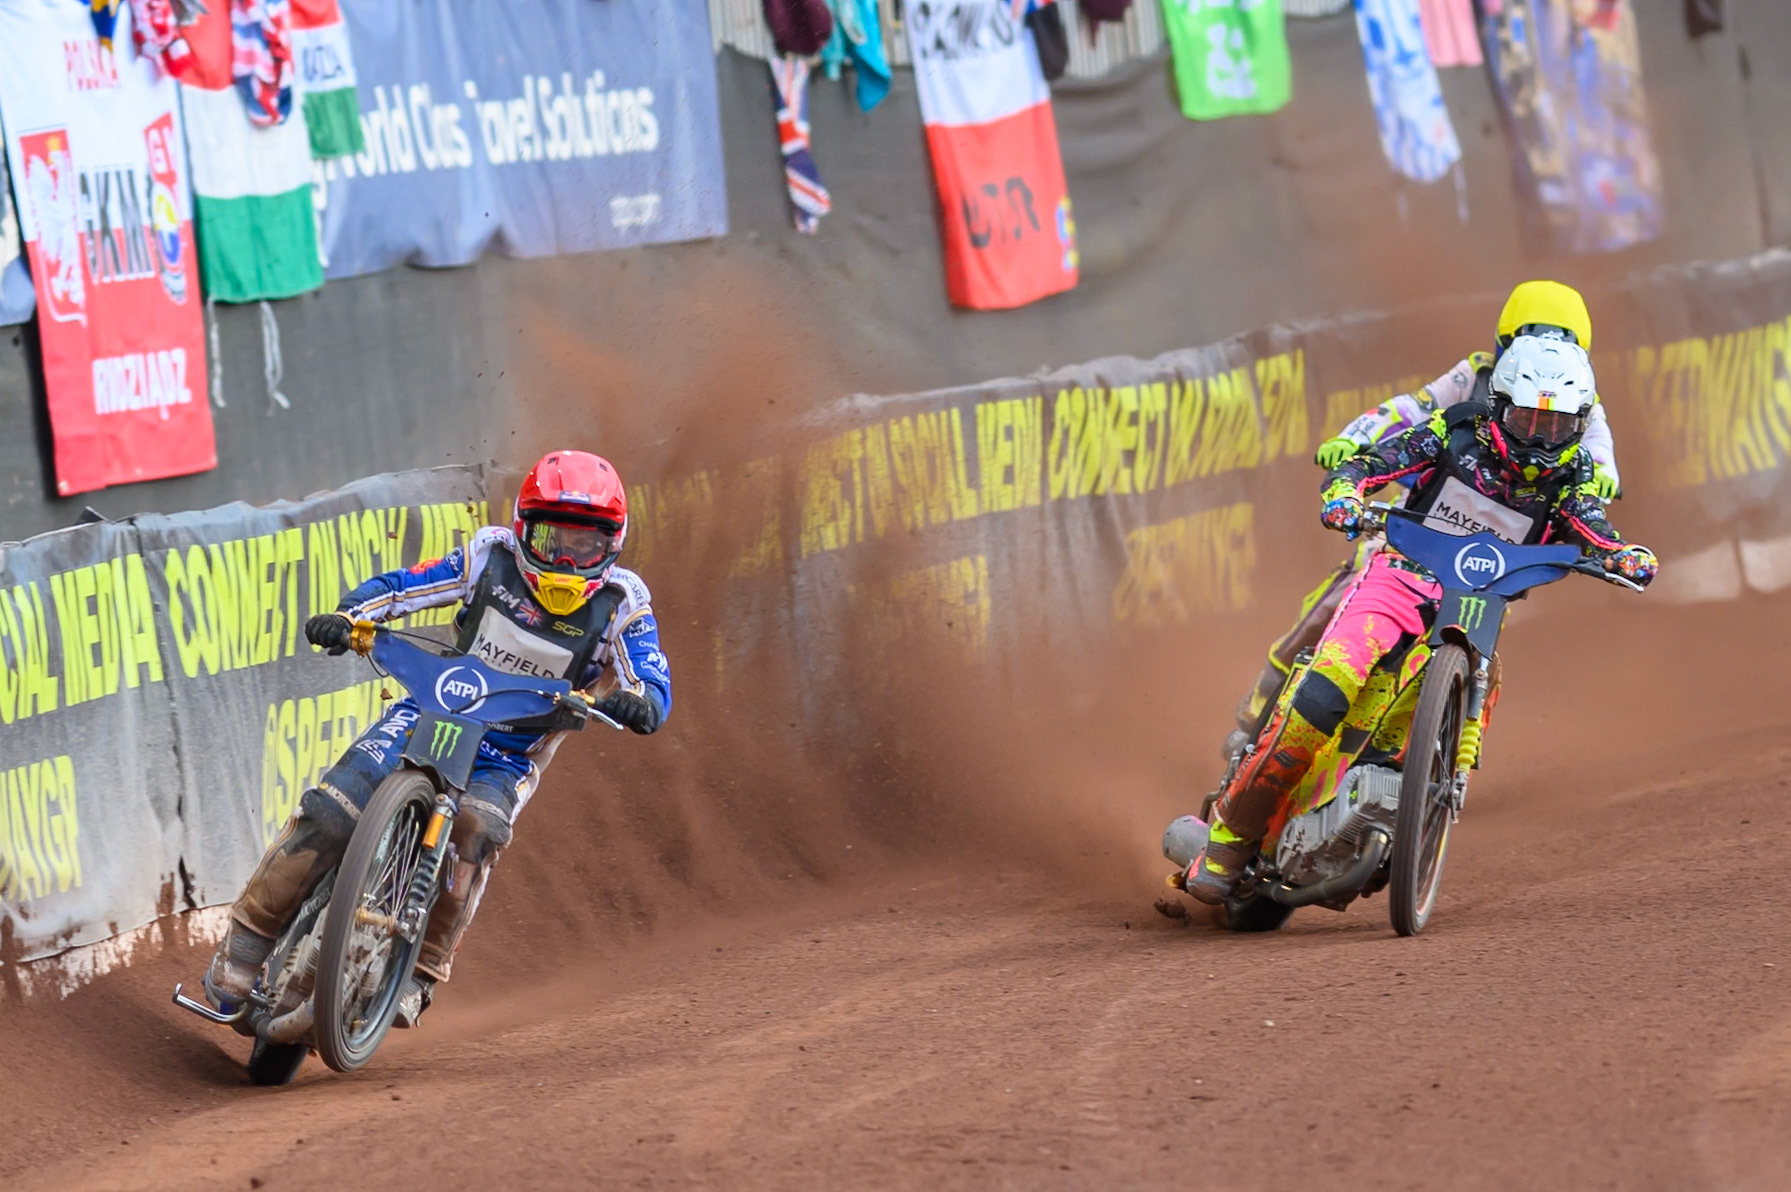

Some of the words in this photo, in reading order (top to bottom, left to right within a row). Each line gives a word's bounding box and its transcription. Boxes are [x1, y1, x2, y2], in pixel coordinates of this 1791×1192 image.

[1462, 556, 1496, 573] ATPI
[552, 620, 584, 637] SGP
[442, 679, 479, 700] ATPI
